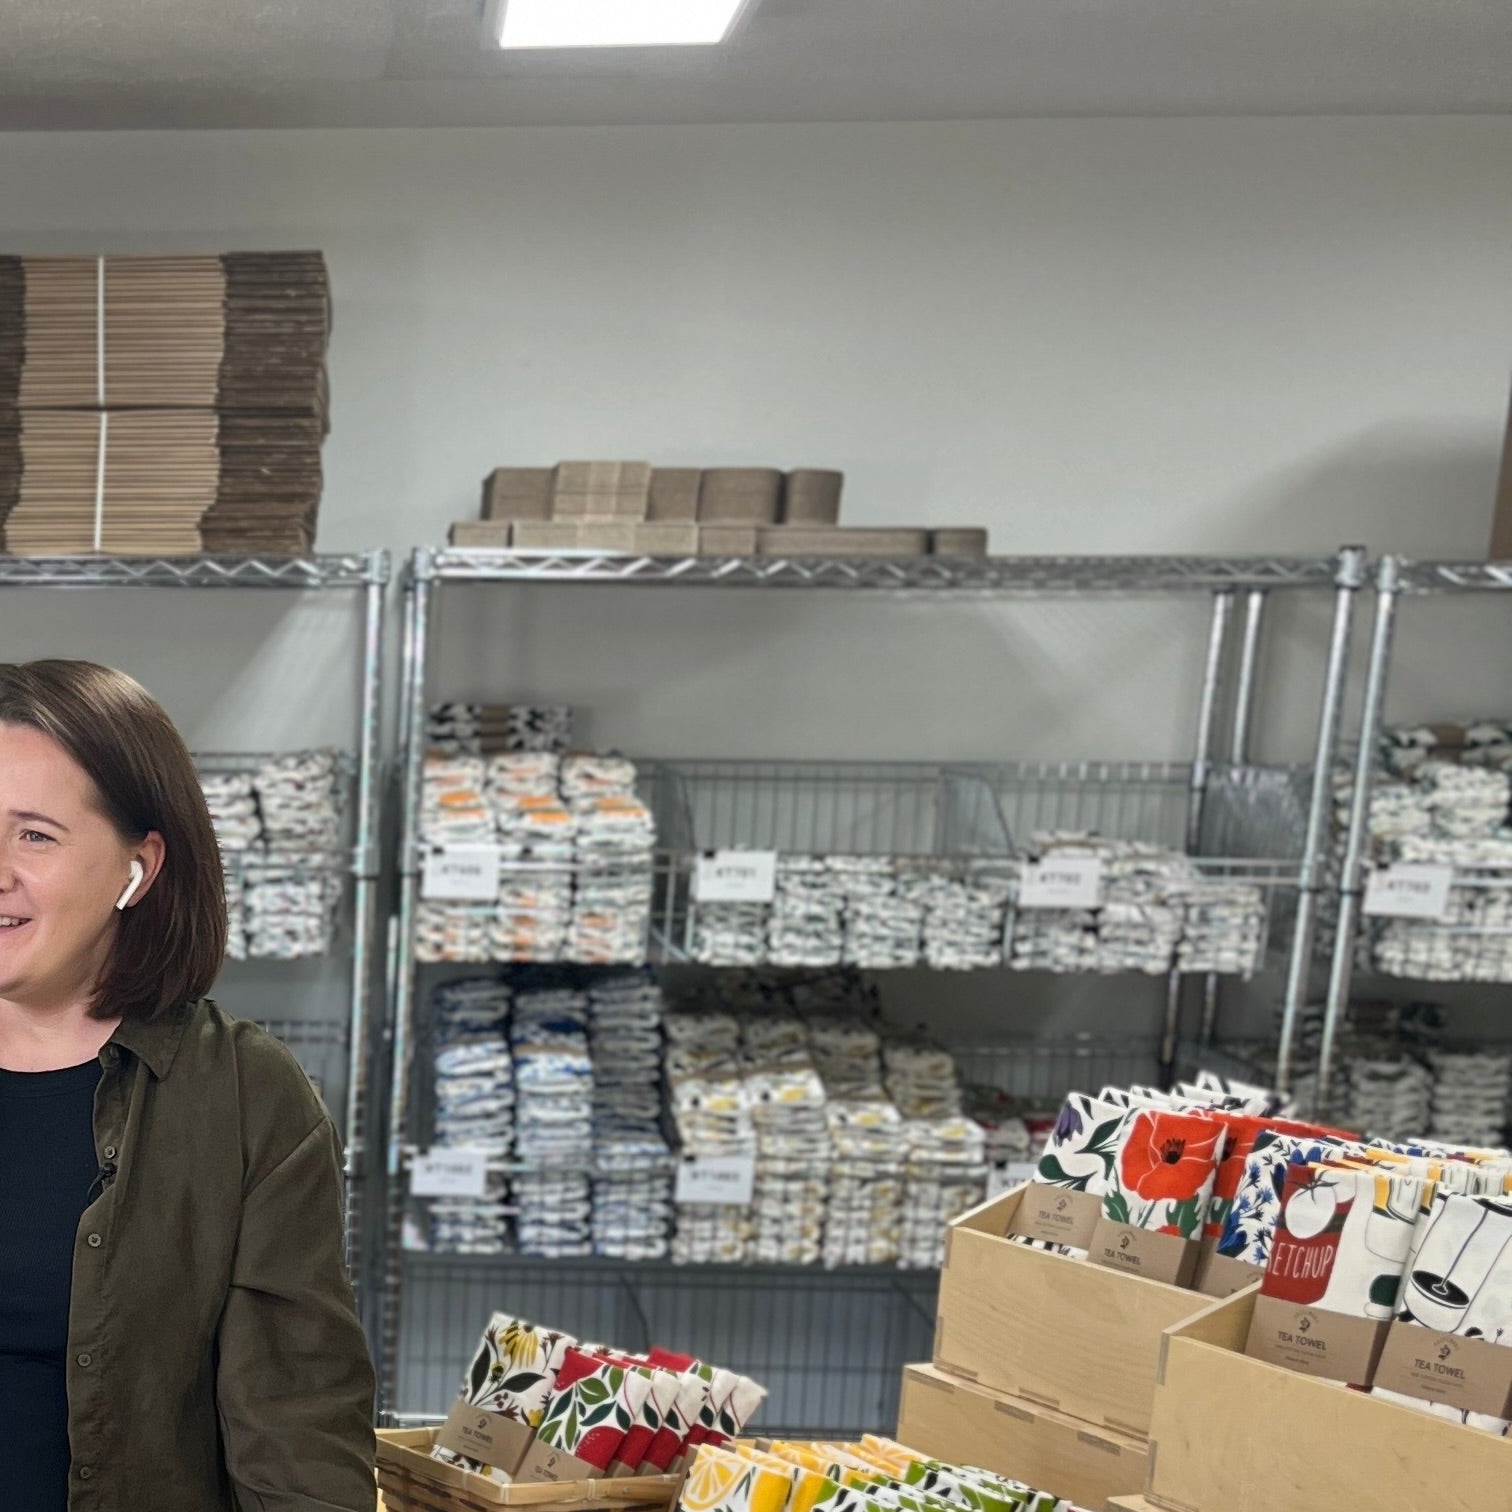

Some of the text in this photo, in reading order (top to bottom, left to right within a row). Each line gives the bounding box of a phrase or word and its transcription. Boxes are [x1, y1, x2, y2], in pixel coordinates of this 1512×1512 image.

[1038, 1210, 1051, 1220] TEA
[1051, 1213, 1075, 1226] TOWEL
[1104, 1248, 1116, 1259] TEA
[1116, 1252, 1141, 1266] TOWEL
[1277, 1330, 1327, 1351] TEA TOWEL
[1414, 1358, 1431, 1371] TEA
[1432, 1363, 1466, 1380] TOWEL
